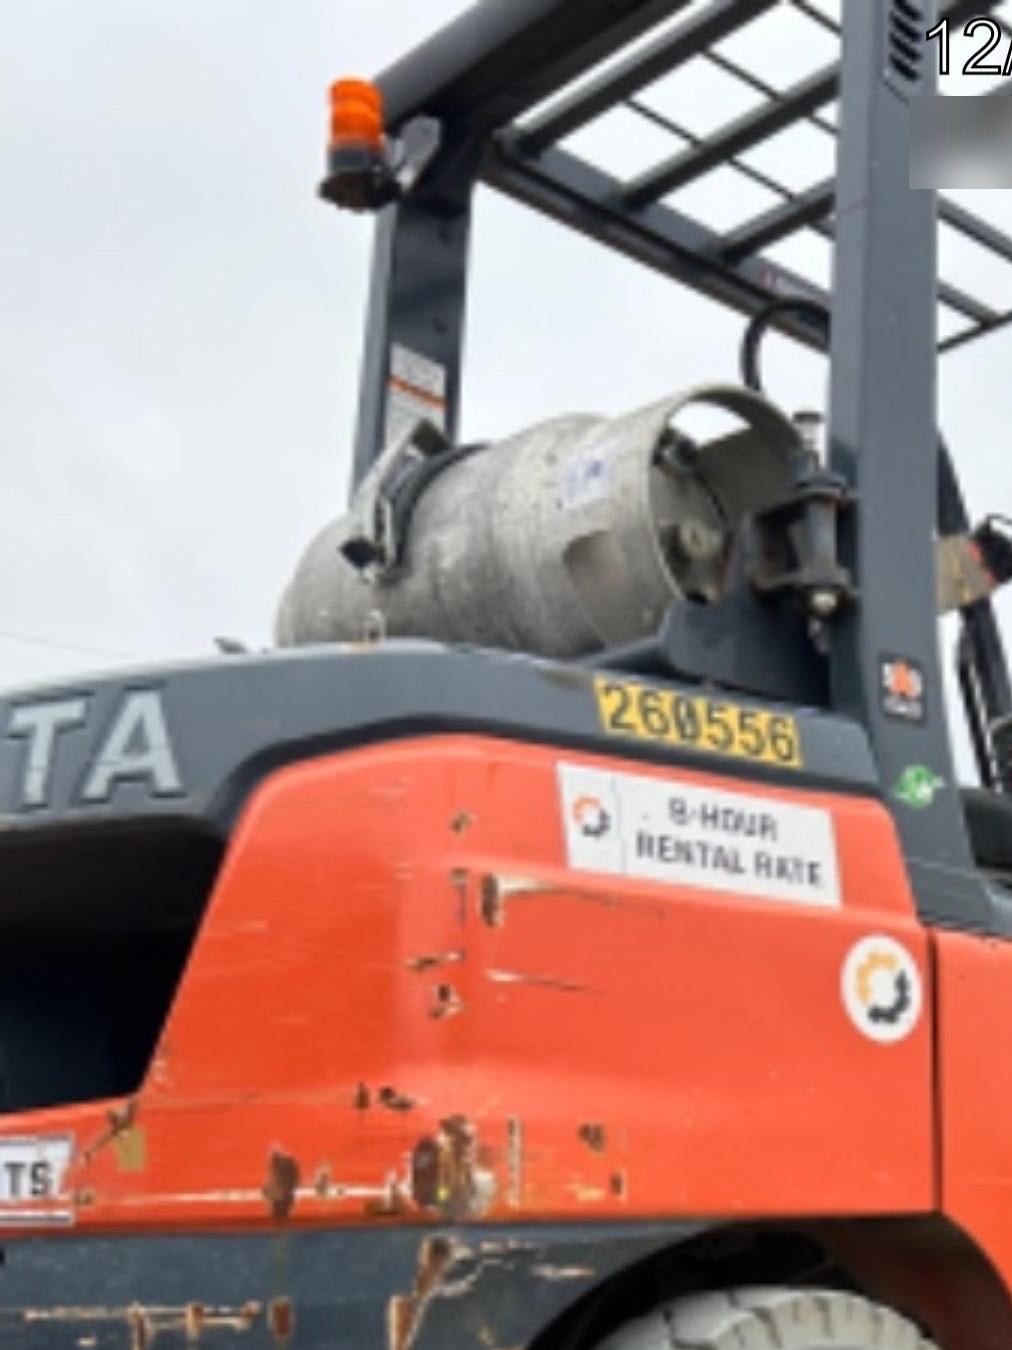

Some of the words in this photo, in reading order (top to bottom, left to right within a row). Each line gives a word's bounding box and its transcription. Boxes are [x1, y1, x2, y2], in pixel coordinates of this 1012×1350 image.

[11, 690, 182, 804] TA
[603, 682, 795, 763] 260556
[635, 830, 746, 874] RENTAL
[755, 850, 822, 886] RATE
